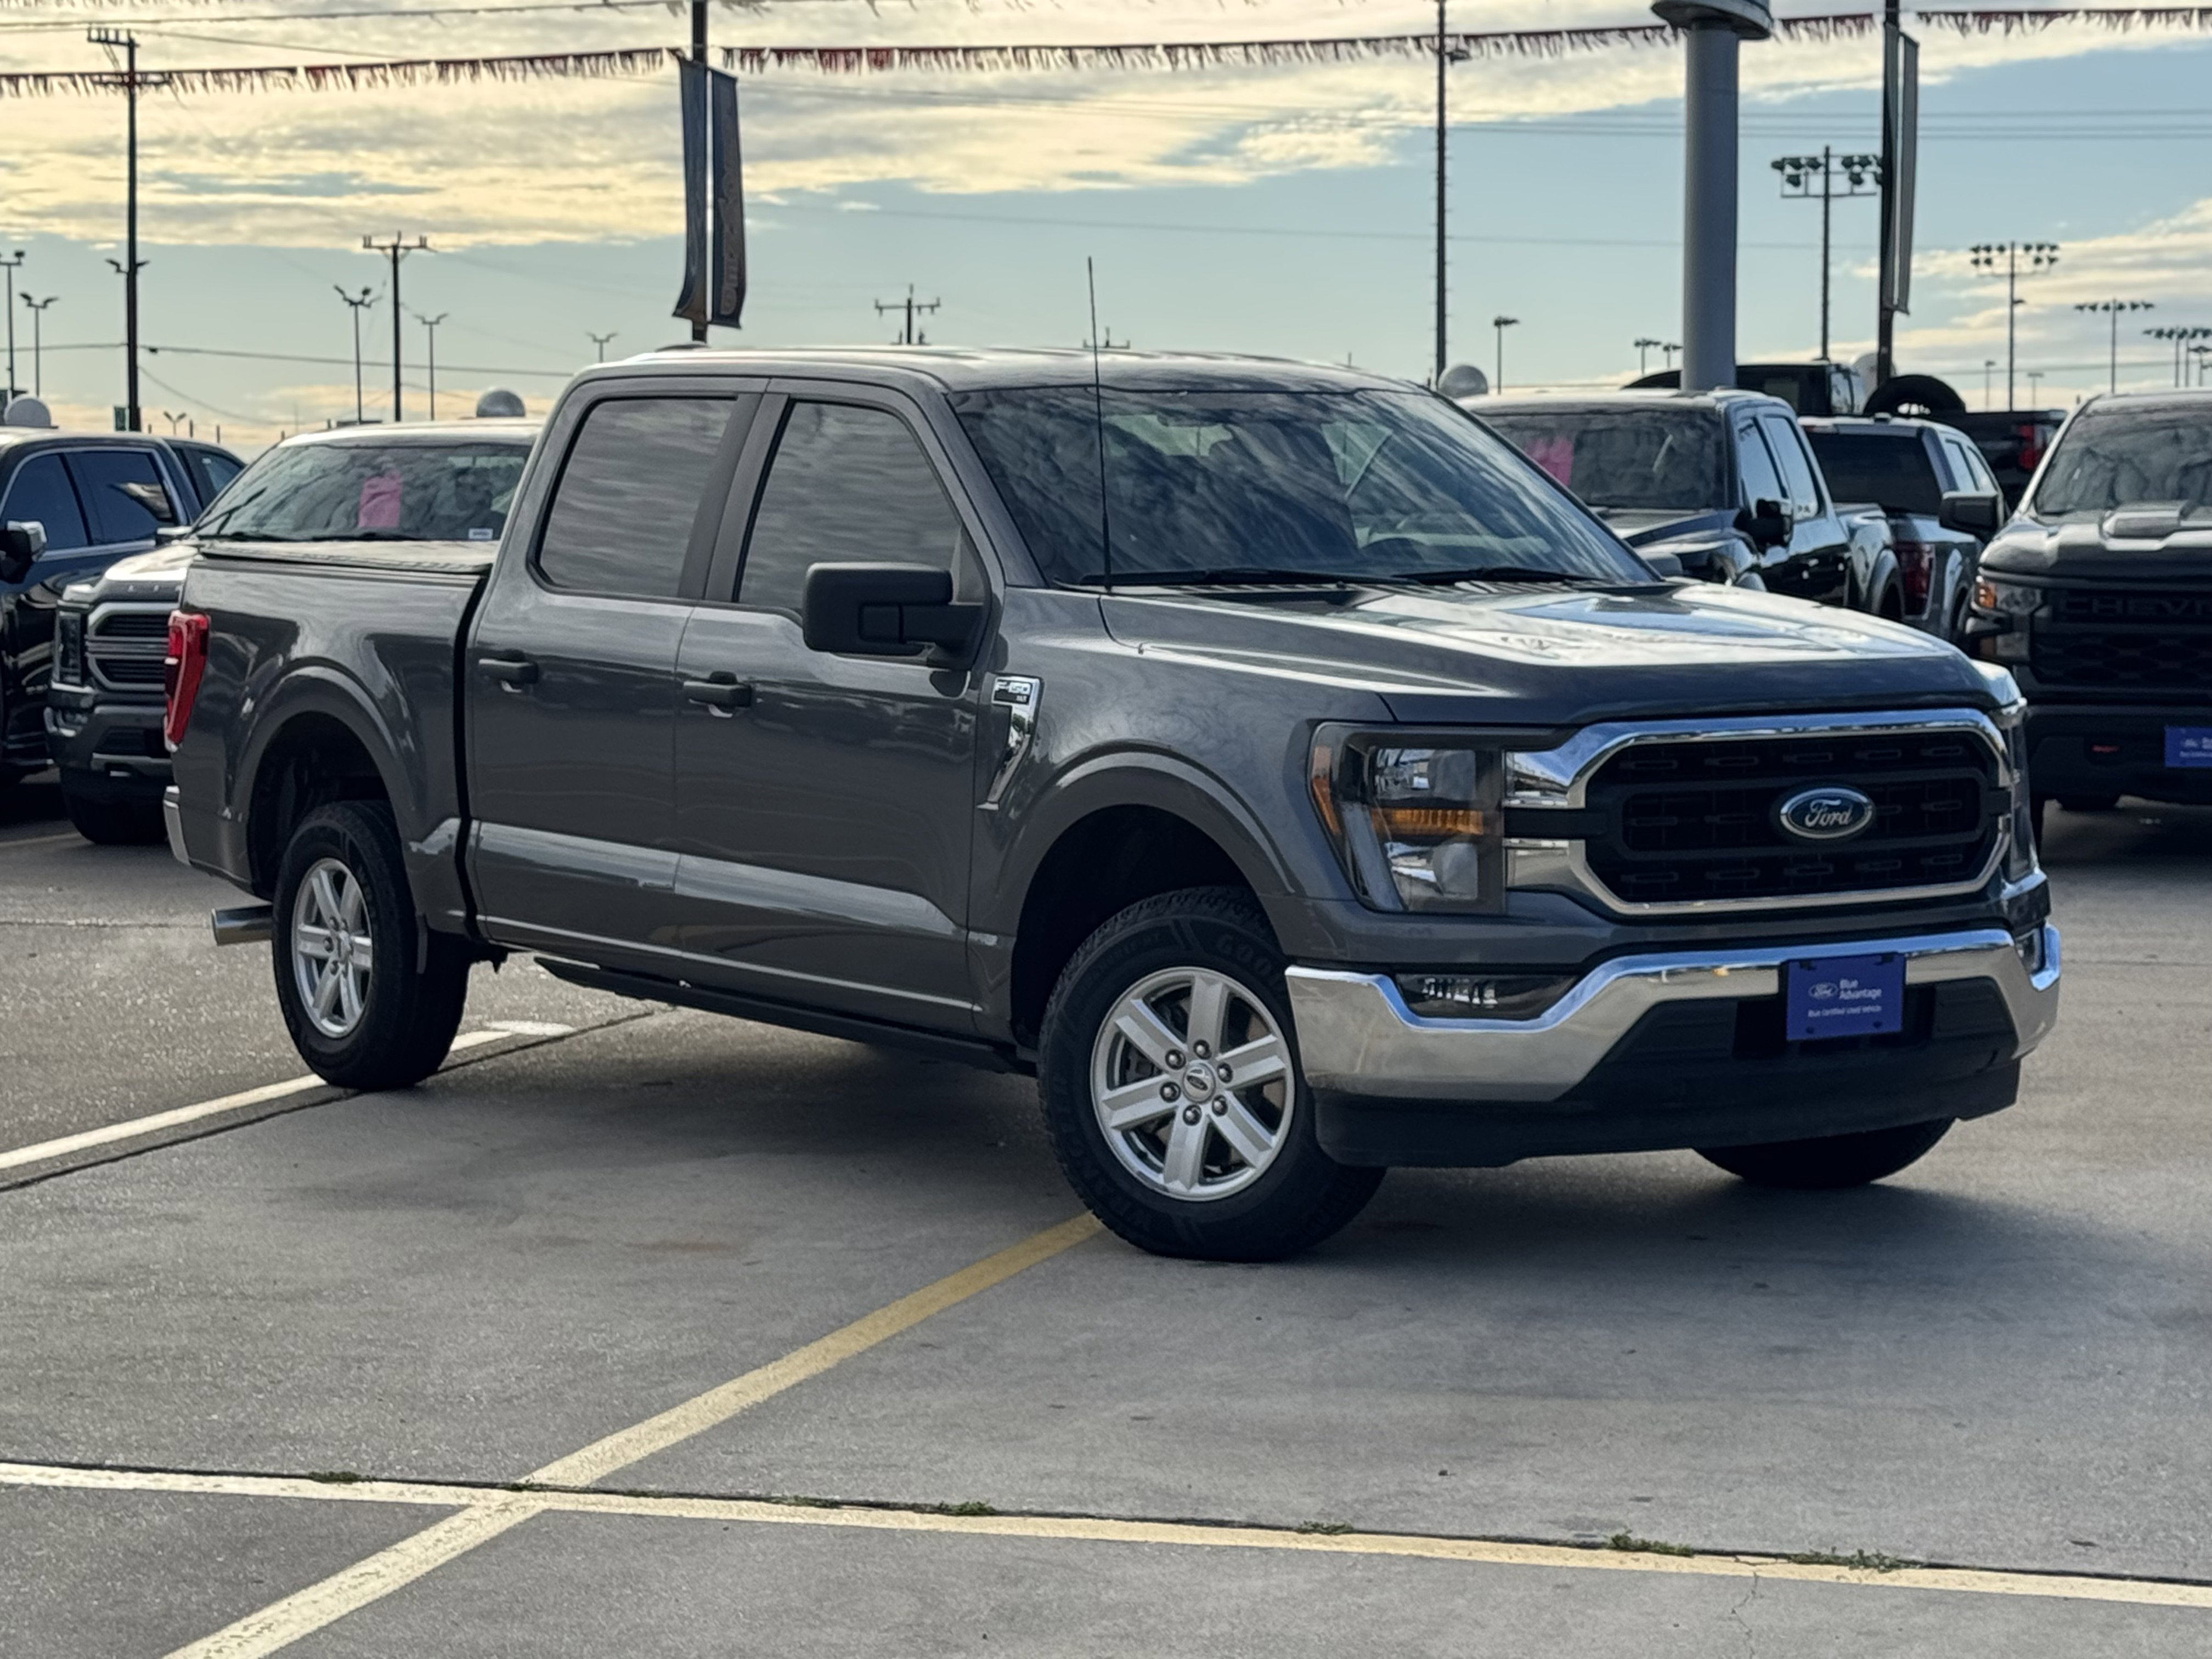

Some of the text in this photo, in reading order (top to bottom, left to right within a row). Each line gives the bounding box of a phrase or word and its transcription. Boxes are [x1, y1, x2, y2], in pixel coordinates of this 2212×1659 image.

[1804, 799, 1853, 827] Ford
[1839, 979, 1859, 989] Blue
[1839, 988, 1882, 1000] Advantage
